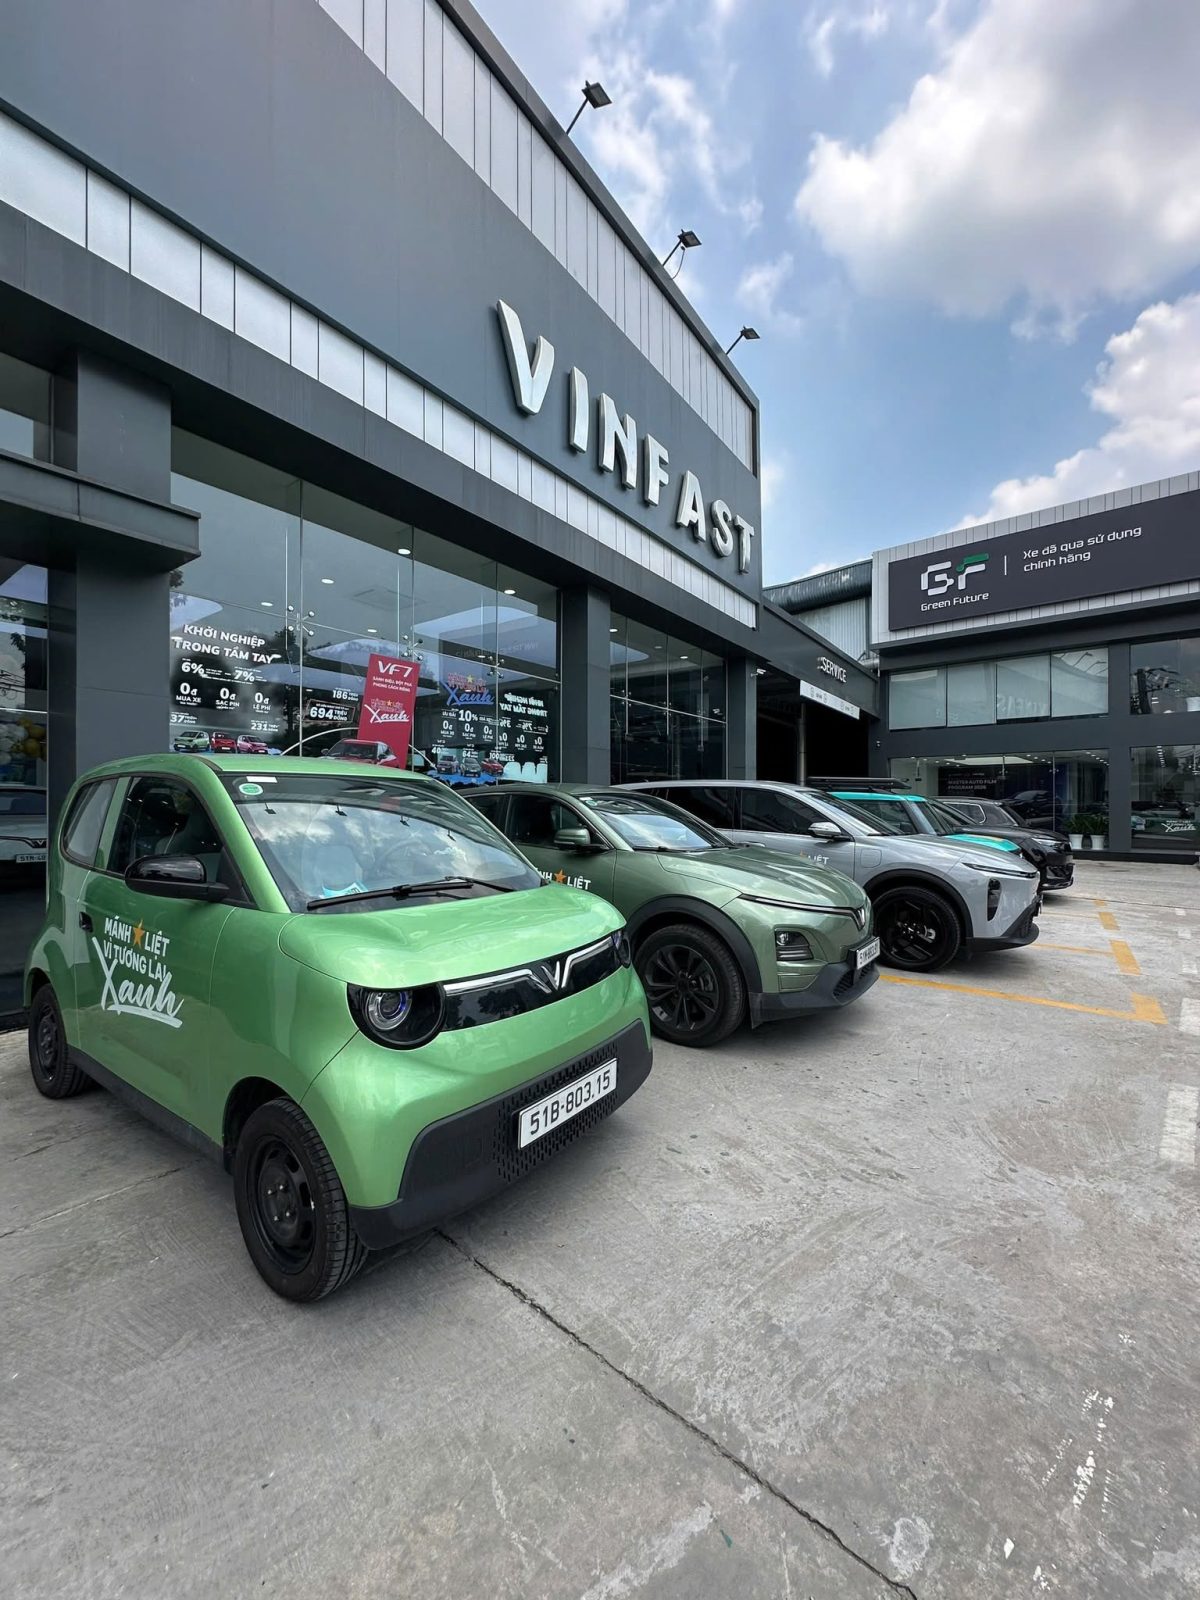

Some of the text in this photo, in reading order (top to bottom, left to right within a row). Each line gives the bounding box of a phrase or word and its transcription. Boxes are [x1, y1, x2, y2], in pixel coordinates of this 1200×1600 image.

[497, 299, 754, 573] VINFAST
[1023, 526, 1142, 560] Xe đã qua sử dụng
[1023, 551, 1091, 573] chính hãng
[921, 592, 989, 612] Green Future
[183, 624, 265, 648] KHỞI NGHIỆP
[172, 637, 220, 655] TRONG
[252, 652, 274, 664] TAY
[181, 661, 204, 674] 6%
[234, 669, 255, 682] 7%
[378, 660, 413, 678] VF7
[820, 657, 847, 683] SERVICE
[333, 690, 348, 699] 186
[439, 680, 495, 706] Xanh
[170, 714, 184, 723] 37
[310, 707, 333, 719] 694
[364, 704, 410, 723] Xanh
[458, 709, 478, 722] 10%
[103, 936, 112, 959] VÌ
[113, 944, 147, 974] TƯƠNG
[144, 930, 170, 960] LIỆT
[92, 936, 184, 1022] Xanh
[530, 1069, 610, 1136] 51B-803.15
